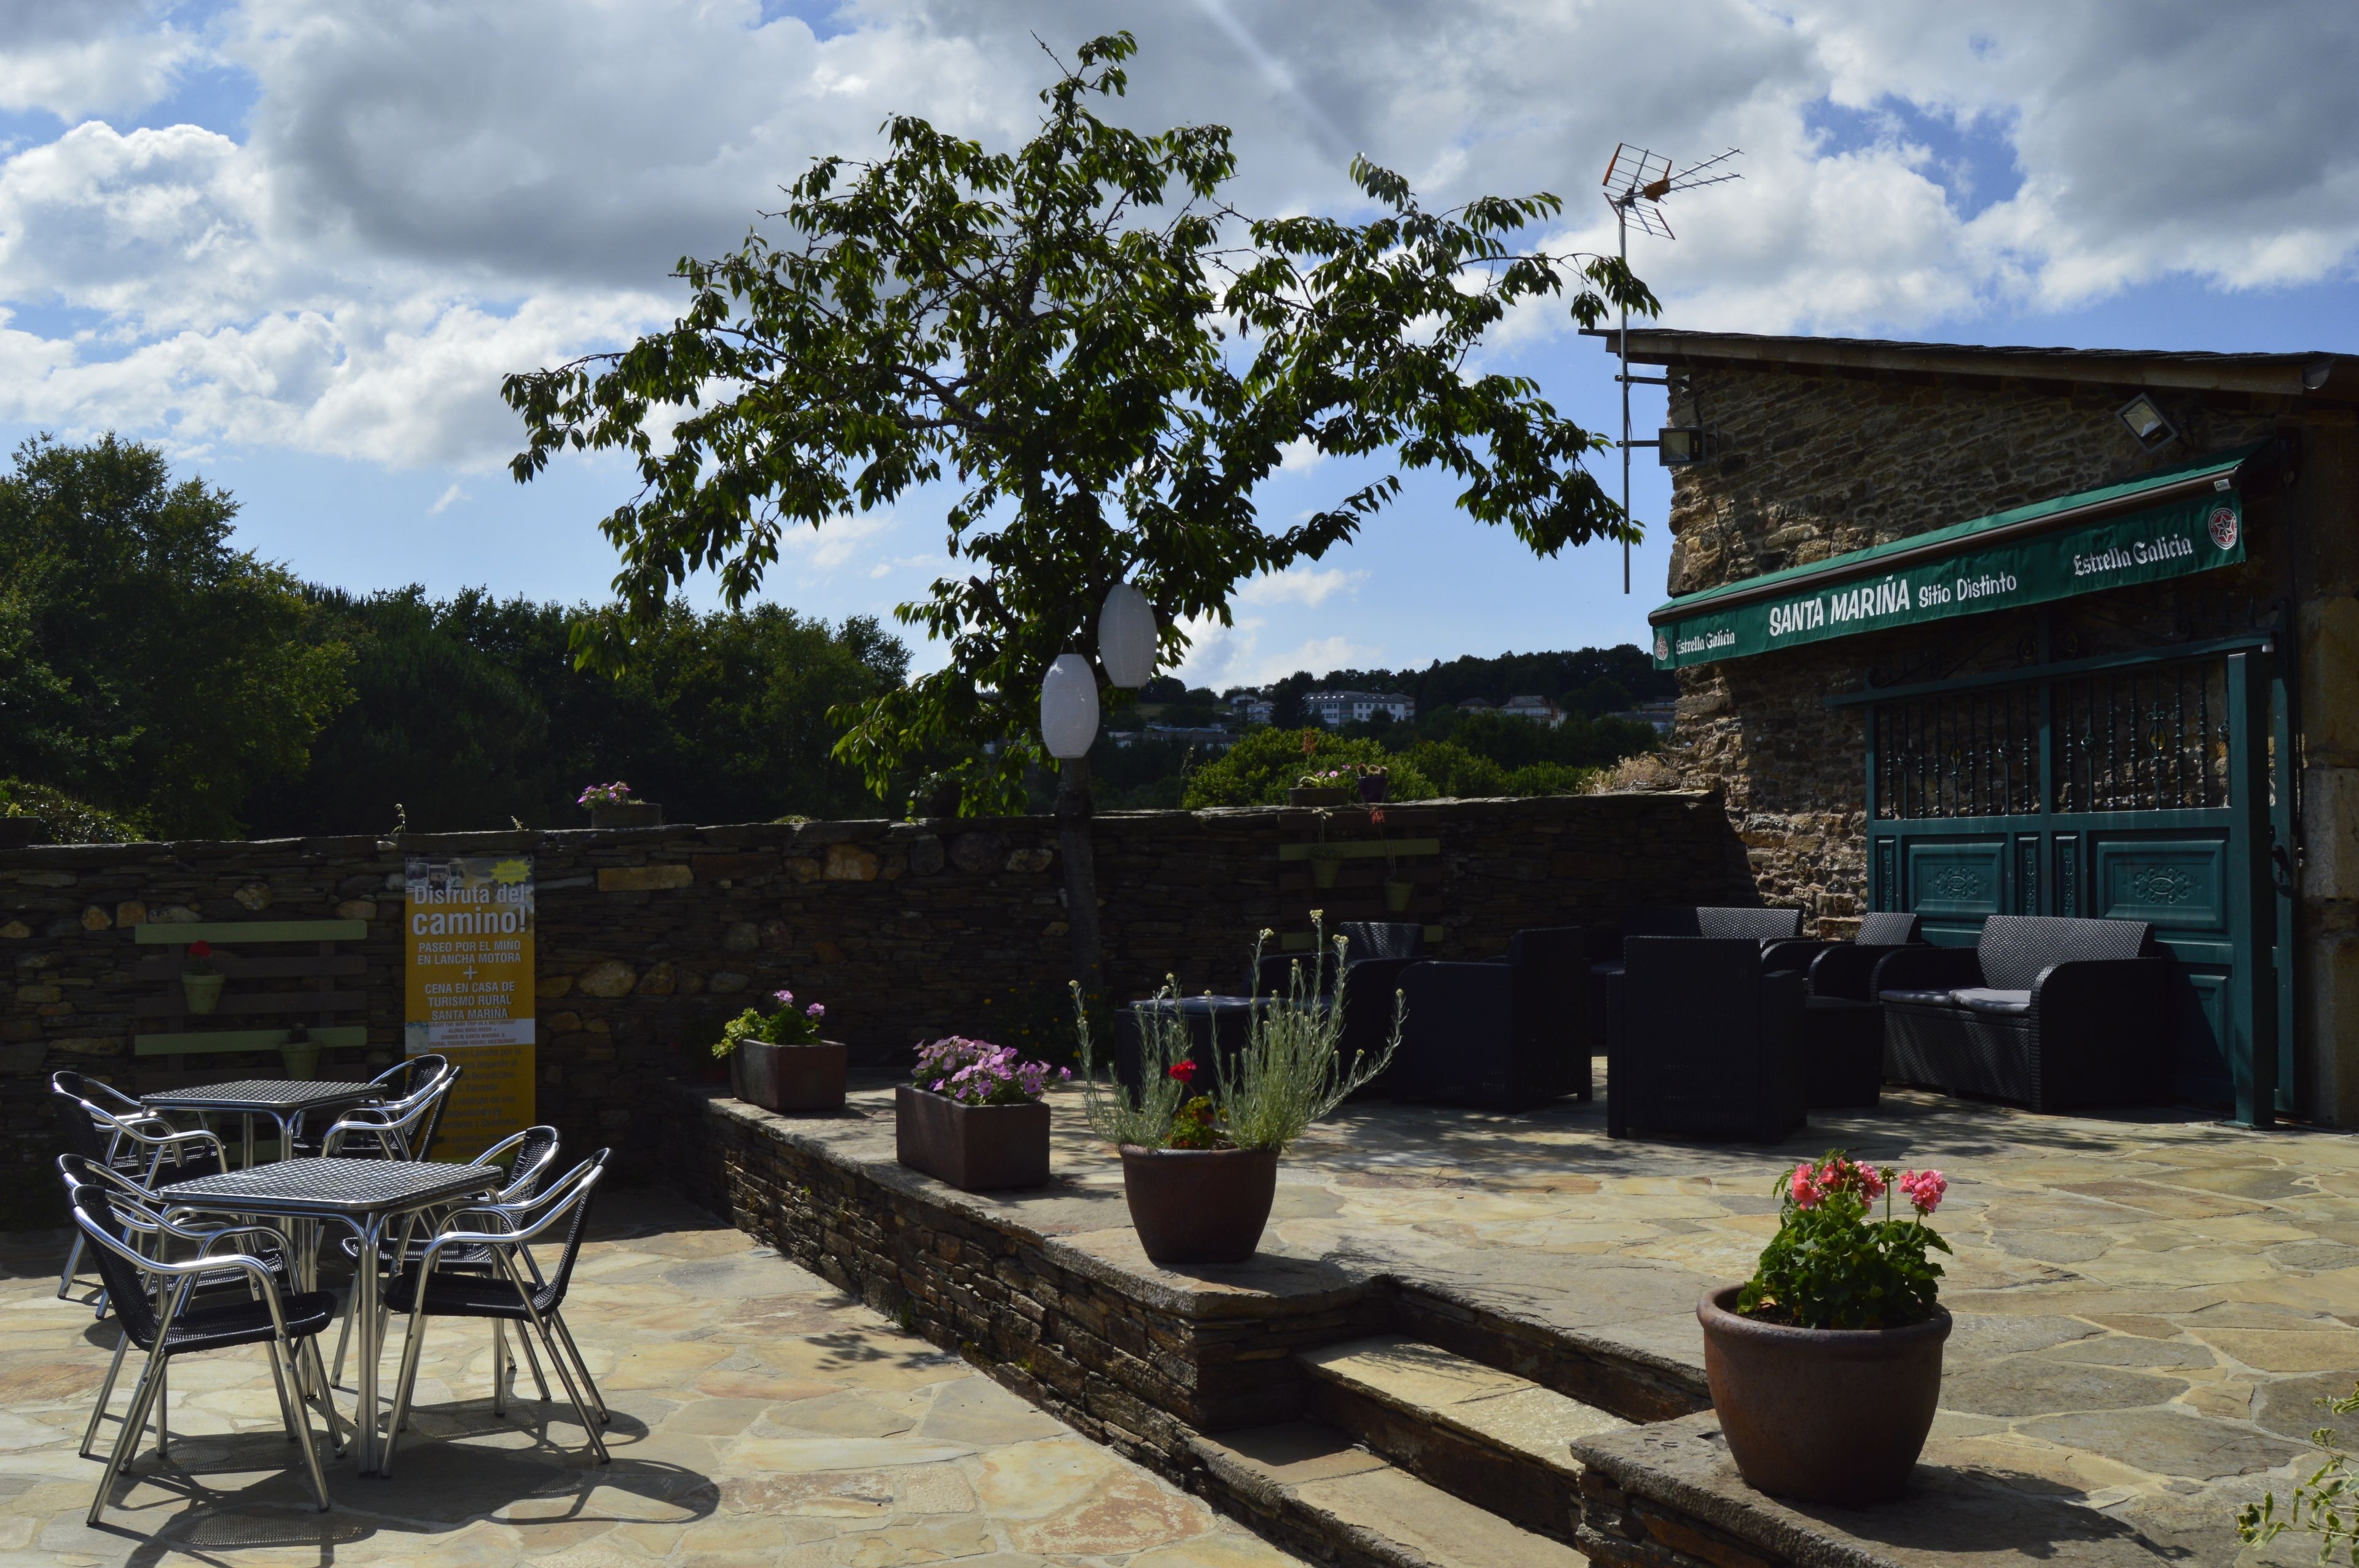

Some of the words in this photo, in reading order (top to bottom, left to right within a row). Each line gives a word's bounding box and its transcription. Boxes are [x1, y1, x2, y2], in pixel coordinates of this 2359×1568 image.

[2073, 545, 2132, 576] Estrella
[2133, 533, 2193, 564] Galicia
[1769, 598, 1823, 636] SANTA
[1830, 575, 1910, 624] MARIÑA
[1919, 583, 1951, 608] Sitio
[1957, 571, 2017, 601] Distinto
[1675, 635, 1705, 655] Estrella
[1705, 628, 1735, 649] Galicia
[414, 884, 490, 904] Disfruta
[496, 884, 525, 903] del
[412, 905, 526, 935] camino!
[419, 942, 452, 952] PASEO
[455, 942, 477, 951] POR
[480, 941, 491, 951] EL
[494, 938, 522, 951] MIÑO
[418, 954, 431, 965] EN
[434, 954, 475, 964] LANCHA
[479, 953, 522, 964] MOTORA
[425, 984, 453, 994] CENA
[455, 983, 469, 993] EN
[472, 983, 499, 993] CASA
[502, 981, 515, 991] DE
[428, 996, 475, 1007] TURISMO
[479, 994, 512, 1005] RURAL
[432, 1010, 465, 1020] SANTA
[468, 1006, 508, 1019] MARIÑA
[477, 1059, 508, 1069] llegando
